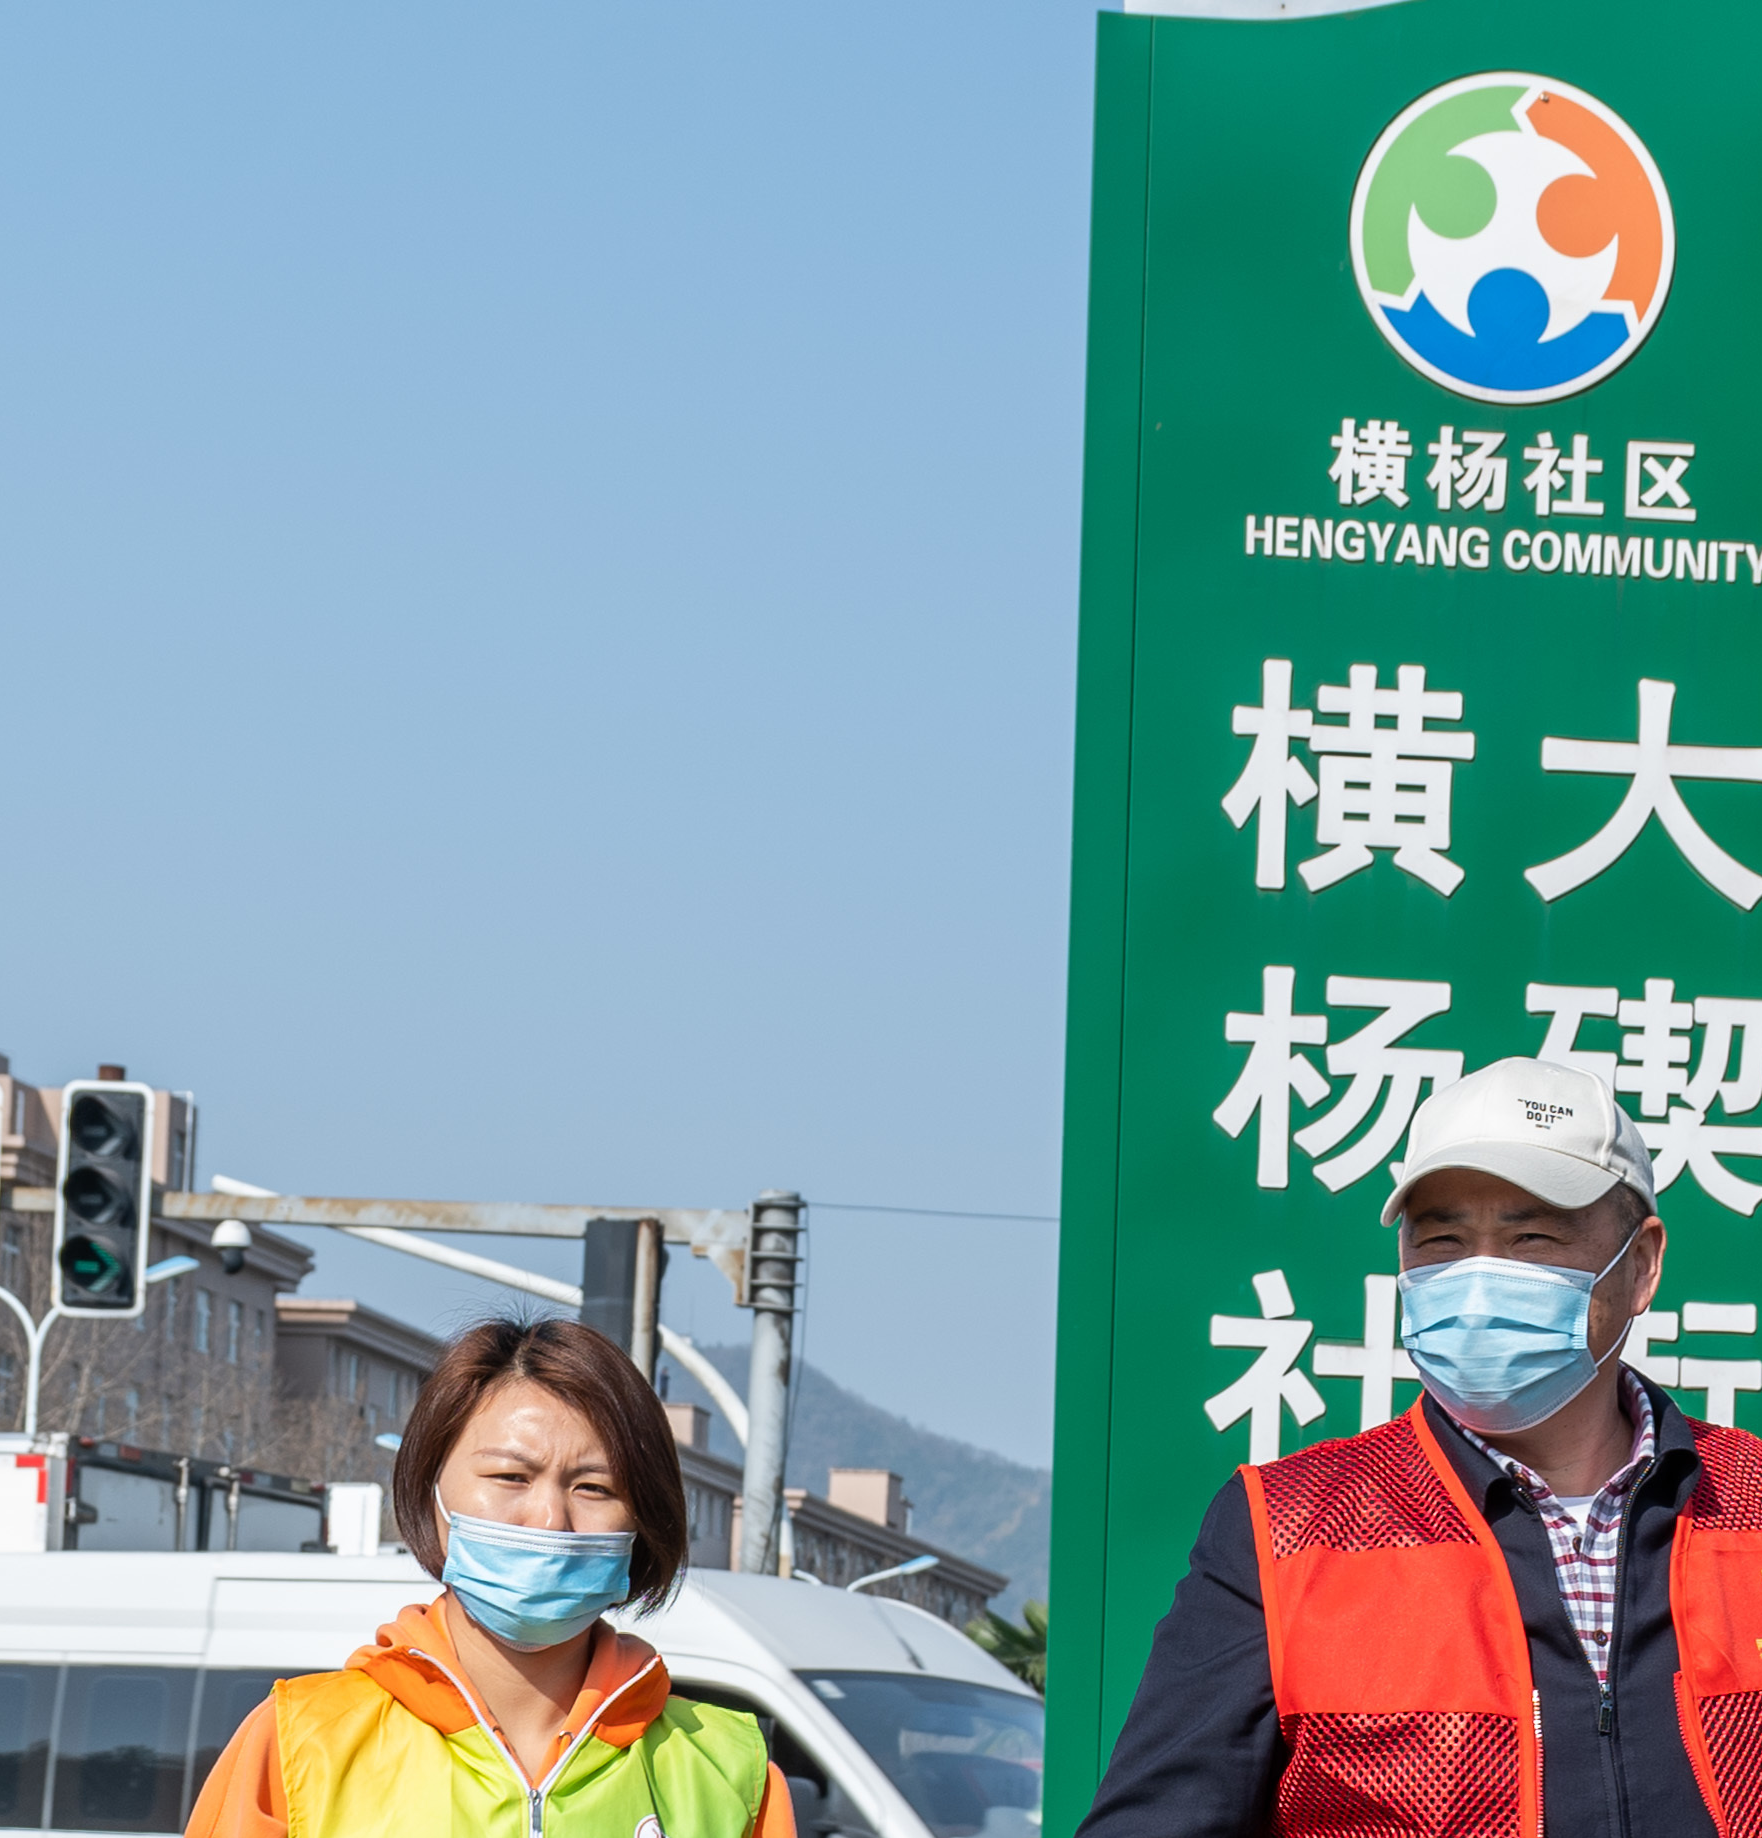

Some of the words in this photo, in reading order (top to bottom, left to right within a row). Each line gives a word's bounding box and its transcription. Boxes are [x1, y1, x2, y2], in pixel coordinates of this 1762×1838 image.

[1327, 417, 1697, 522] 横杨社区
[1245, 514, 1490, 570] HENGYANG
[1526, 1110, 1542, 1122] DO
[1549, 1104, 1574, 1118] CAN
